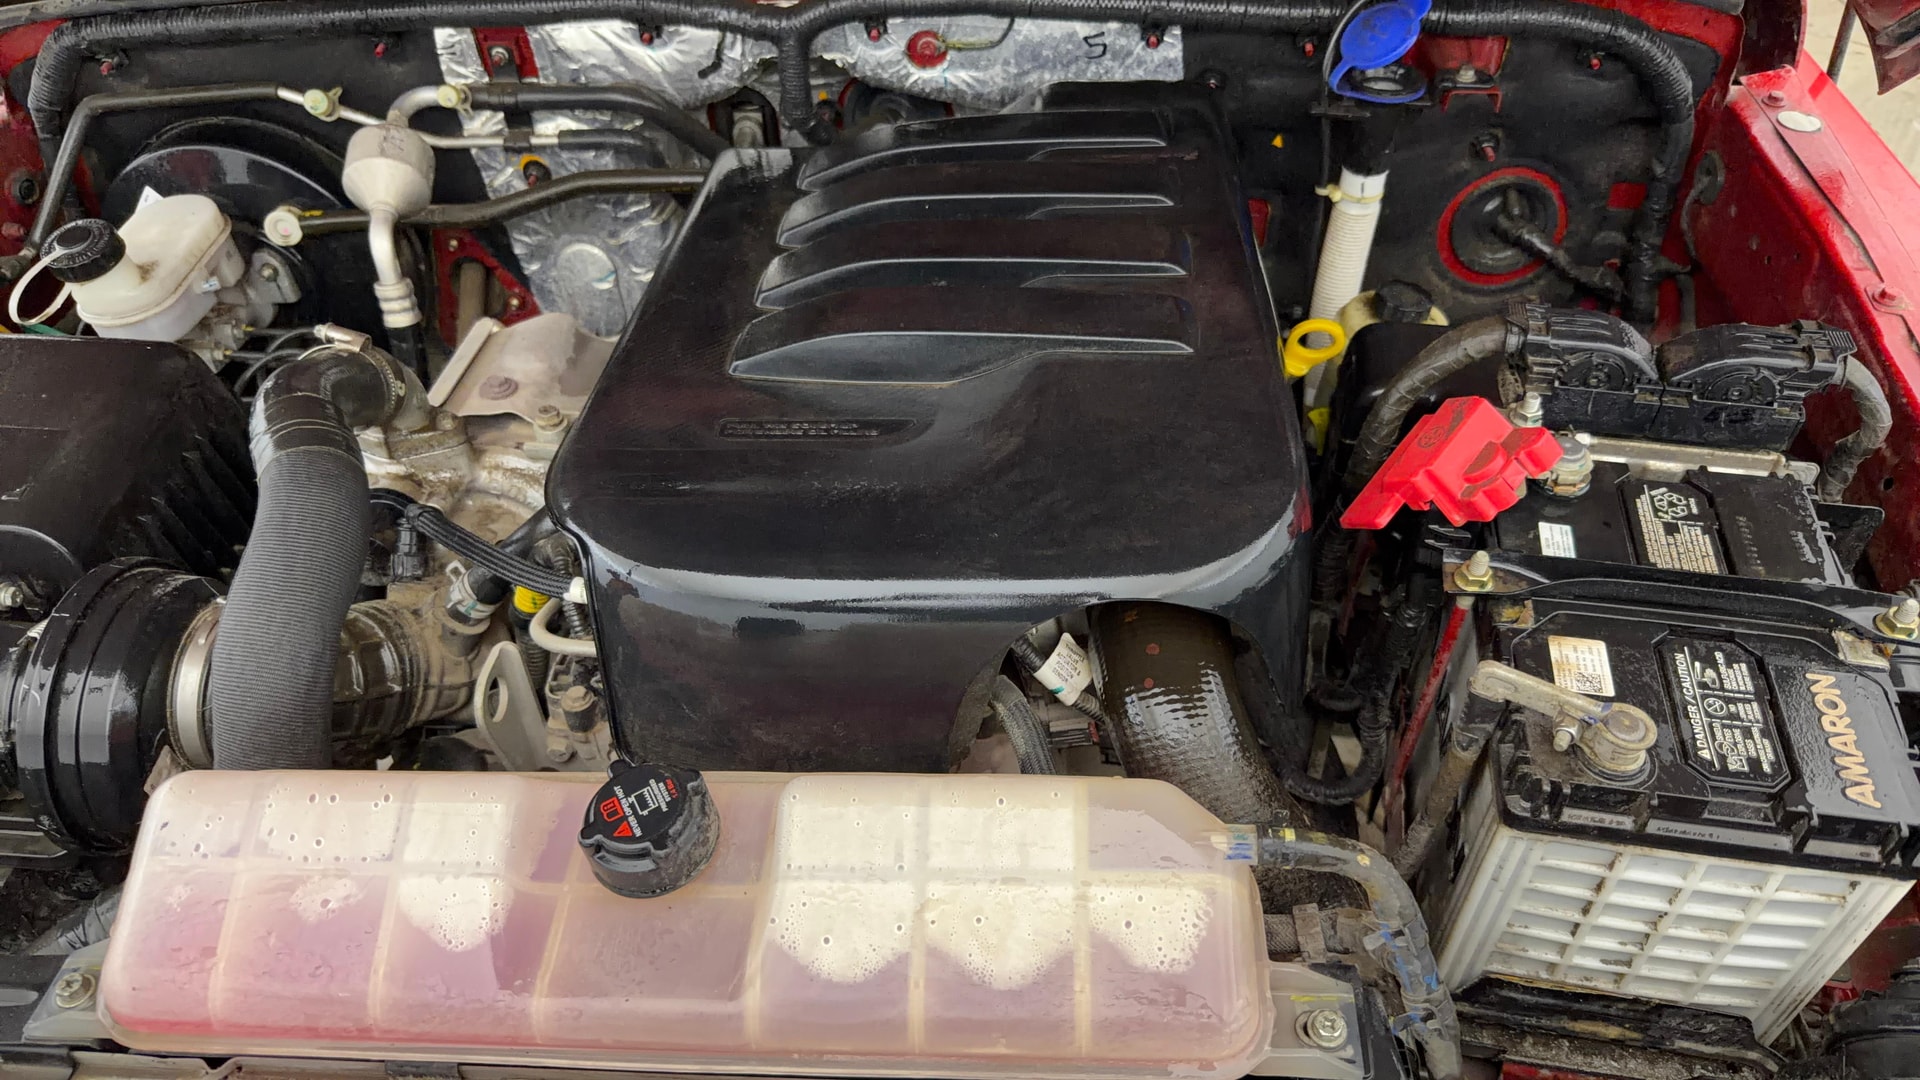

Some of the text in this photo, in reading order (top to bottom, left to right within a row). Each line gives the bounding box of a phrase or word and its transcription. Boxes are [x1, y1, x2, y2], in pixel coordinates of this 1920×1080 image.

[1056, 661, 1074, 679] POSITION
[1687, 705, 1707, 747] DANGER
[1723, 728, 1734, 742] EYES
[1805, 672, 1882, 809] AMARON
[658, 783, 671, 802] SYSTEM
[614, 786, 643, 838] NEVER OPEN HOT
